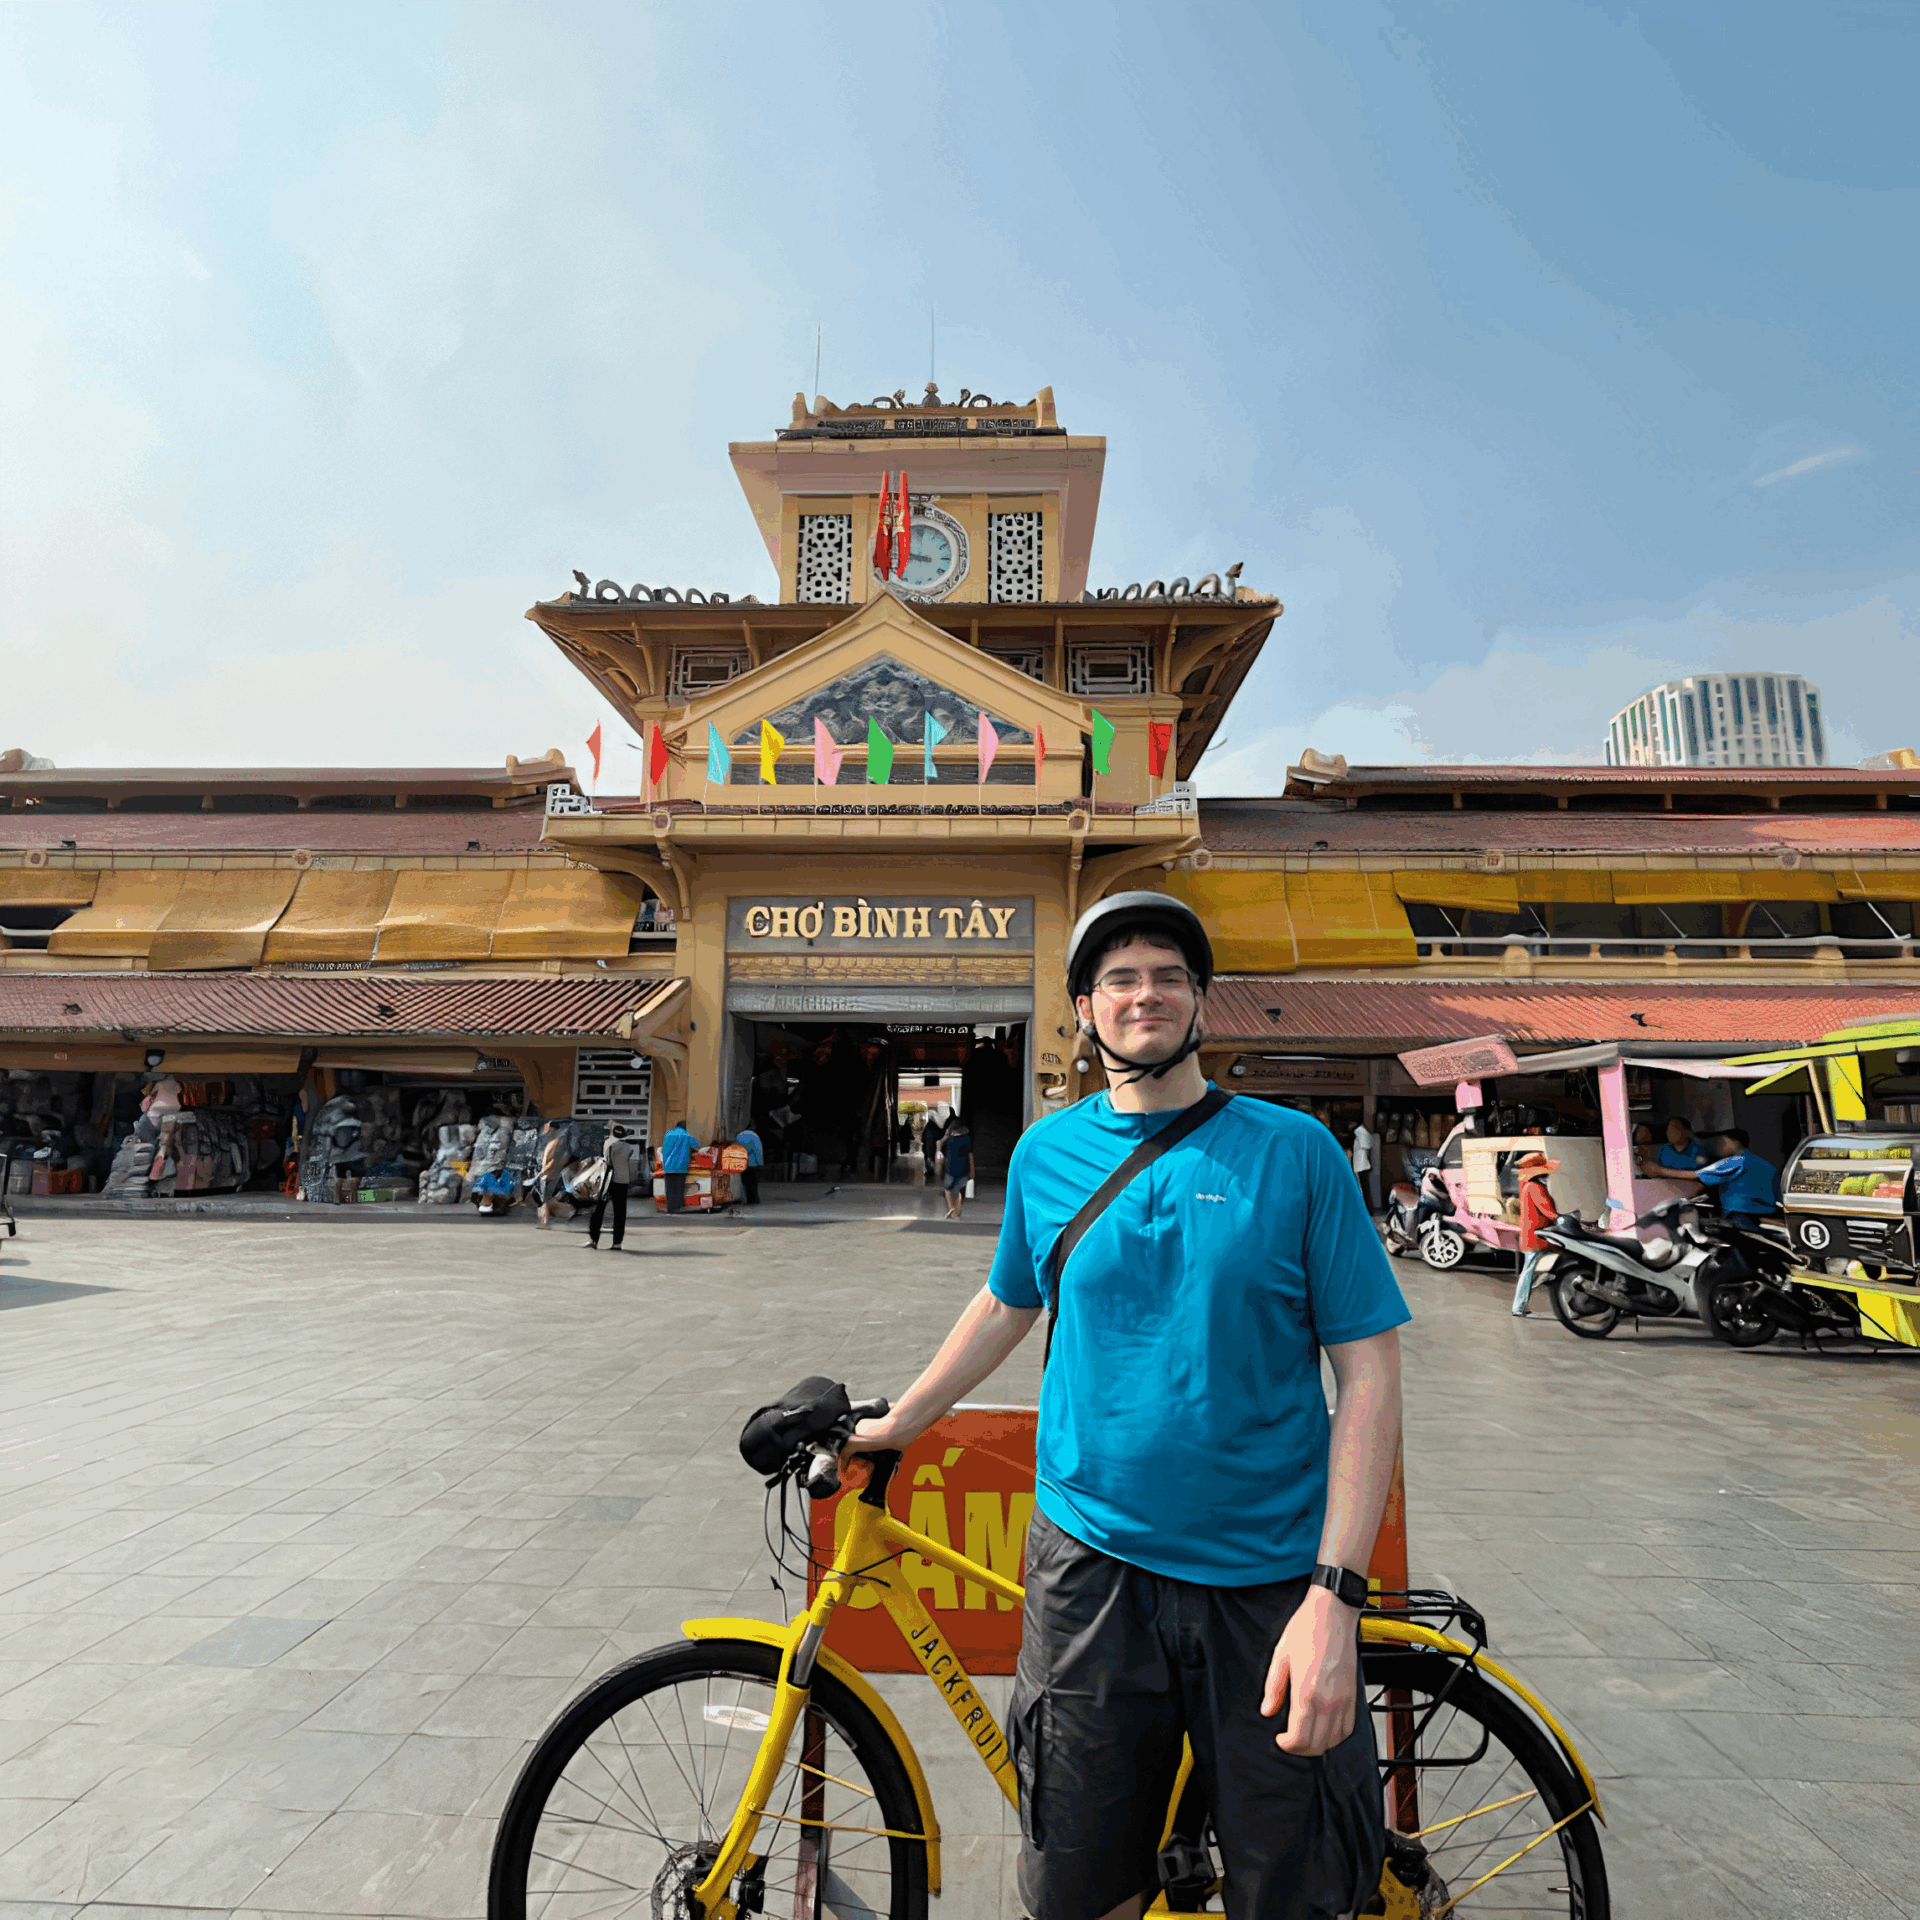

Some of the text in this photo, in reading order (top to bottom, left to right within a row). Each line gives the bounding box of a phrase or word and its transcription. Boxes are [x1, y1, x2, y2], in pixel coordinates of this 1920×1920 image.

[746, 897, 1017, 945] CHỢ BÌNH TÂY
